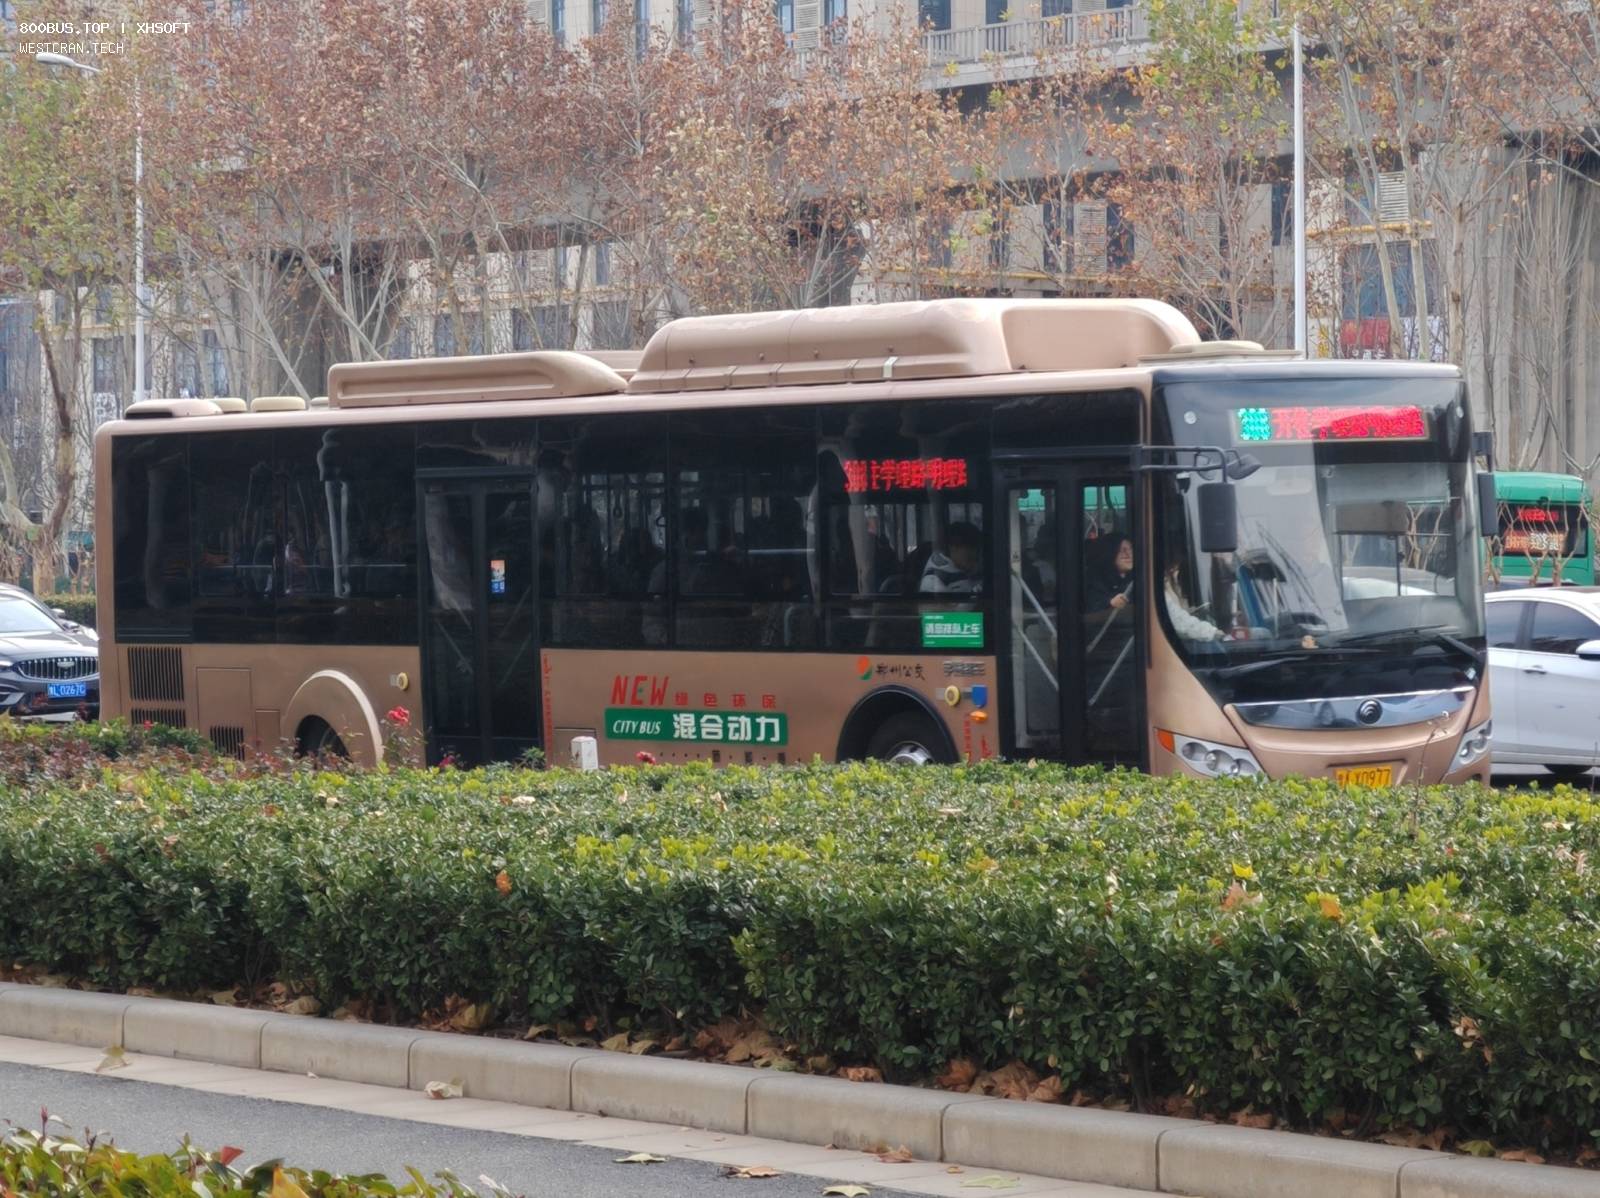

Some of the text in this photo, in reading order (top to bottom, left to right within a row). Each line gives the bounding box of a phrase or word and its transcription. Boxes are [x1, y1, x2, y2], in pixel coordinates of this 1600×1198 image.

[611, 675, 669, 706] NEW
[674, 692, 776, 709] 绿色环保
[612, 720, 662, 735] CITY BUS
[672, 713, 781, 743] 混合动力
